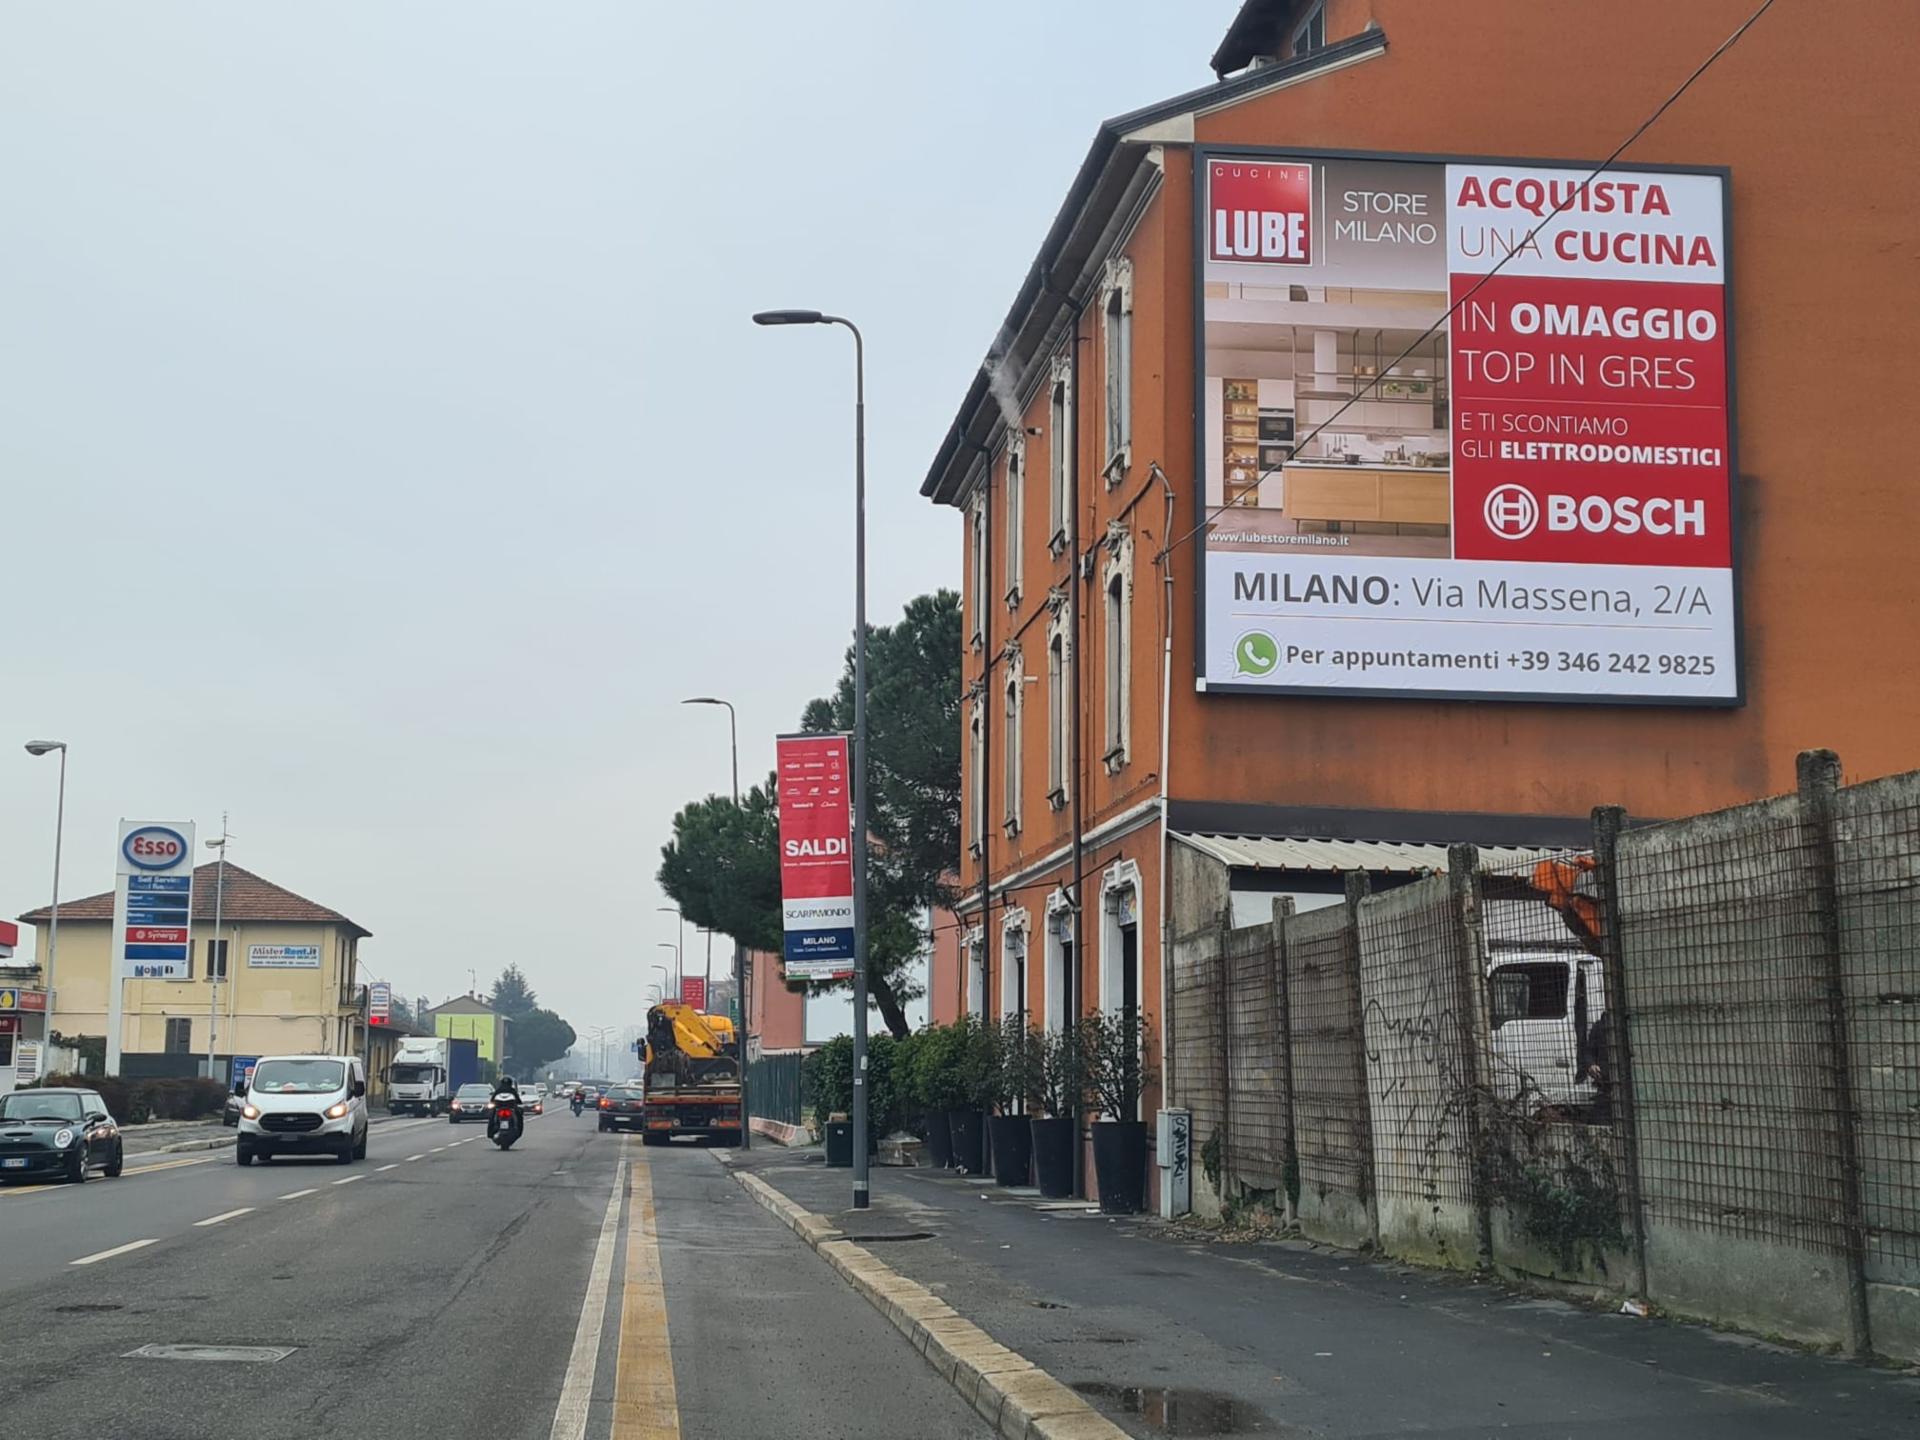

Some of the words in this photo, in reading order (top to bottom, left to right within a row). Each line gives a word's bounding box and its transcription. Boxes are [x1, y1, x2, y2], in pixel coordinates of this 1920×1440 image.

[1215, 167, 1305, 181] CUCINE
[1343, 191, 1428, 215] STORE
[1457, 176, 1671, 217] ACQUISTA
[1215, 209, 1305, 259] LUBE
[1335, 220, 1437, 245] MILANO
[1460, 226, 1543, 259] UNA
[1554, 230, 1717, 267] CUCINA
[1461, 301, 1496, 332] IN
[1510, 302, 1717, 341] OMAGGIO
[1459, 350, 1535, 383] TOP
[1550, 354, 1585, 385] IN
[1600, 355, 1696, 390] GRES
[1461, 412, 1472, 431] E
[1478, 413, 1495, 432] TI
[1502, 414, 1629, 436] SCONTIAMO
[1461, 439, 1493, 458] GLI
[1500, 441, 1721, 466] ELETTRODOMESTICI
[1548, 495, 1705, 536] BOSCH
[1208, 531, 1349, 546] www.lubestoremilano.it
[1234, 572, 1400, 606] MILANO:
[1412, 577, 1464, 608] Via
[1478, 579, 1640, 618] Massena,
[1654, 585, 1712, 615] 2/A
[1287, 645, 1324, 665] Per
[1332, 647, 1499, 672] appuntamenti
[1507, 650, 1550, 671] +39
[1557, 652, 1600, 673] 346
[1608, 653, 1651, 674] 242
[1659, 654, 1715, 676] 9825
[785, 838, 847, 857] SALDI
[785, 908, 851, 919] SCARPAMONDO
[803, 936, 836, 945] MILANO
